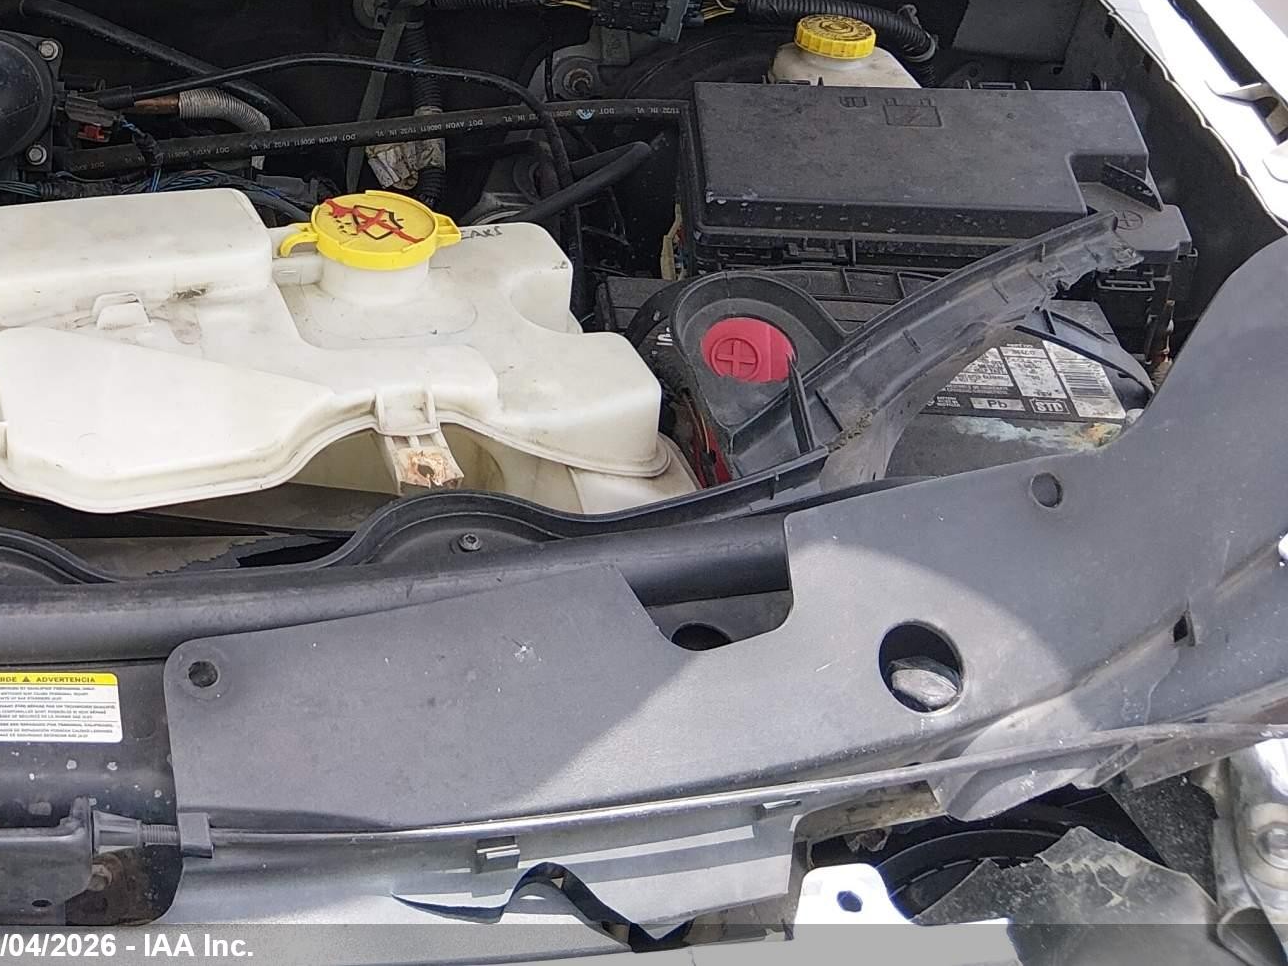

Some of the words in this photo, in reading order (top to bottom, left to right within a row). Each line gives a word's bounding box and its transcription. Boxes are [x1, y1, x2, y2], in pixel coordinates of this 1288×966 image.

[445, 121, 465, 130] AVON
[468, 119, 483, 128] DOT
[987, 399, 1008, 409] Pb
